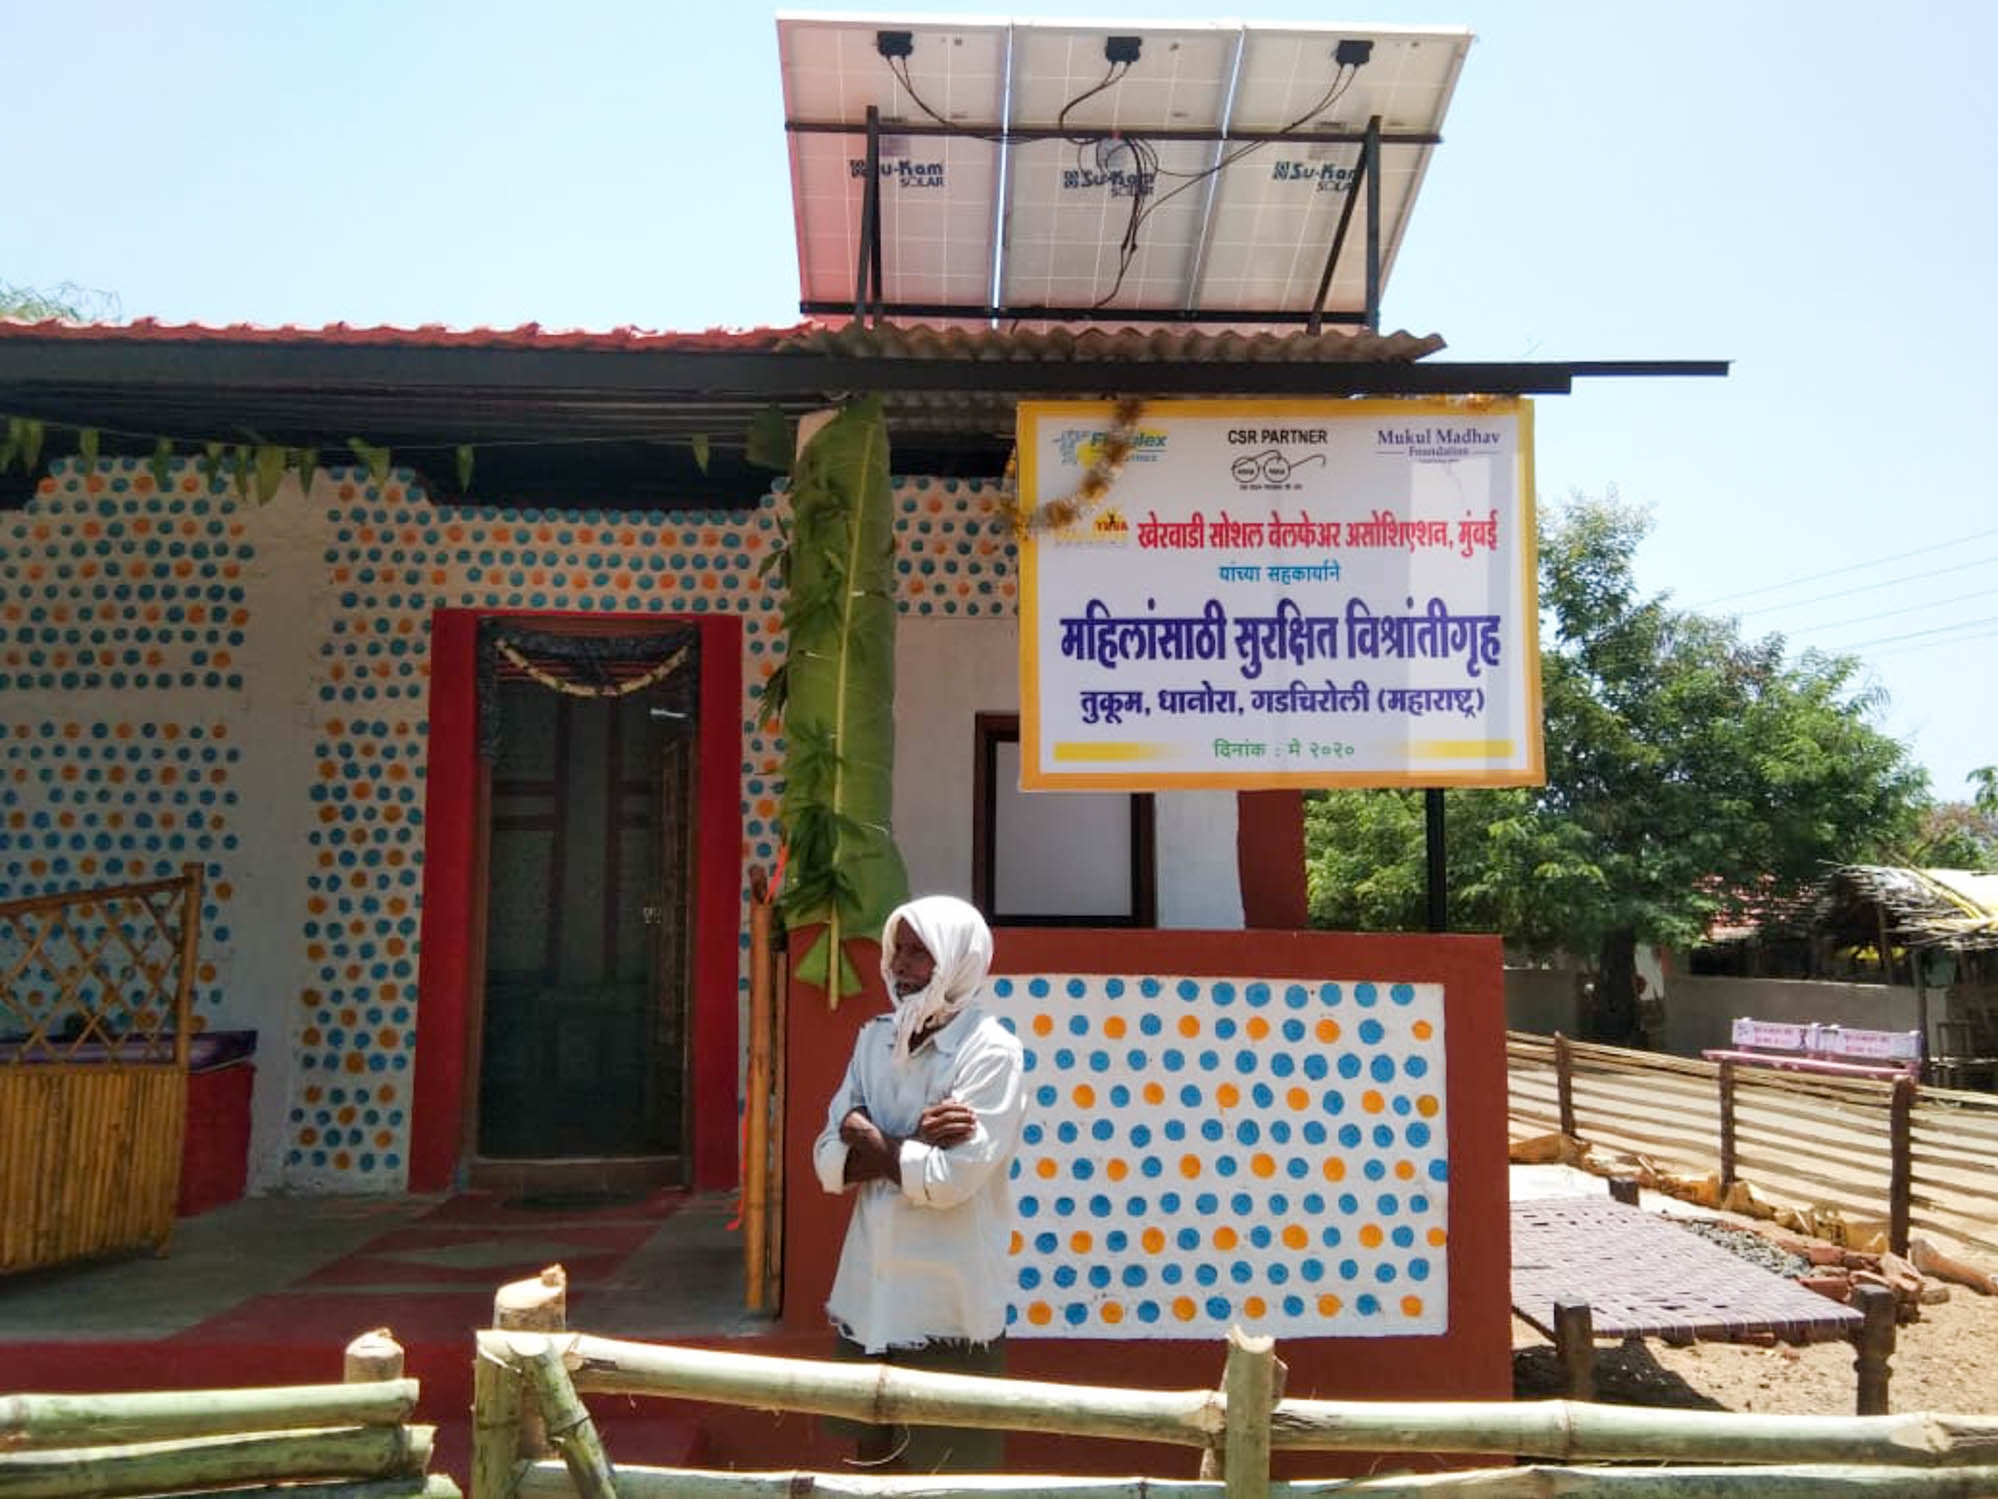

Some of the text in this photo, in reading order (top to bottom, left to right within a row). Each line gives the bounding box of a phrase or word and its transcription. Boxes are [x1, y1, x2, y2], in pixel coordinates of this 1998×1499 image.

[880, 160, 943, 176] u-Kam
[1111, 184, 1154, 197] SOLR
[1228, 430, 1328, 444] CSR PARTNER
[1378, 428, 1500, 445] Mukul Madhav
[1138, 511, 1204, 549] खेरवाडी
[1209, 510, 1264, 549] सोशल
[1267, 510, 1341, 549] वेलफेअर
[1345, 510, 1453, 553] असोशिएशन,
[1219, 558, 1340, 585] यांच्या सहकार्याने
[1060, 596, 1501, 679] महिलांसाठी सुरक्षित विश्रांतीगृह
[1080, 679, 1485, 724] तुकूम, धानोरा, गडचिरोली (महाराष्ट्र)
[1213, 738, 1267, 758] दिनांक
[1309, 742, 1355, 758] २०२०
